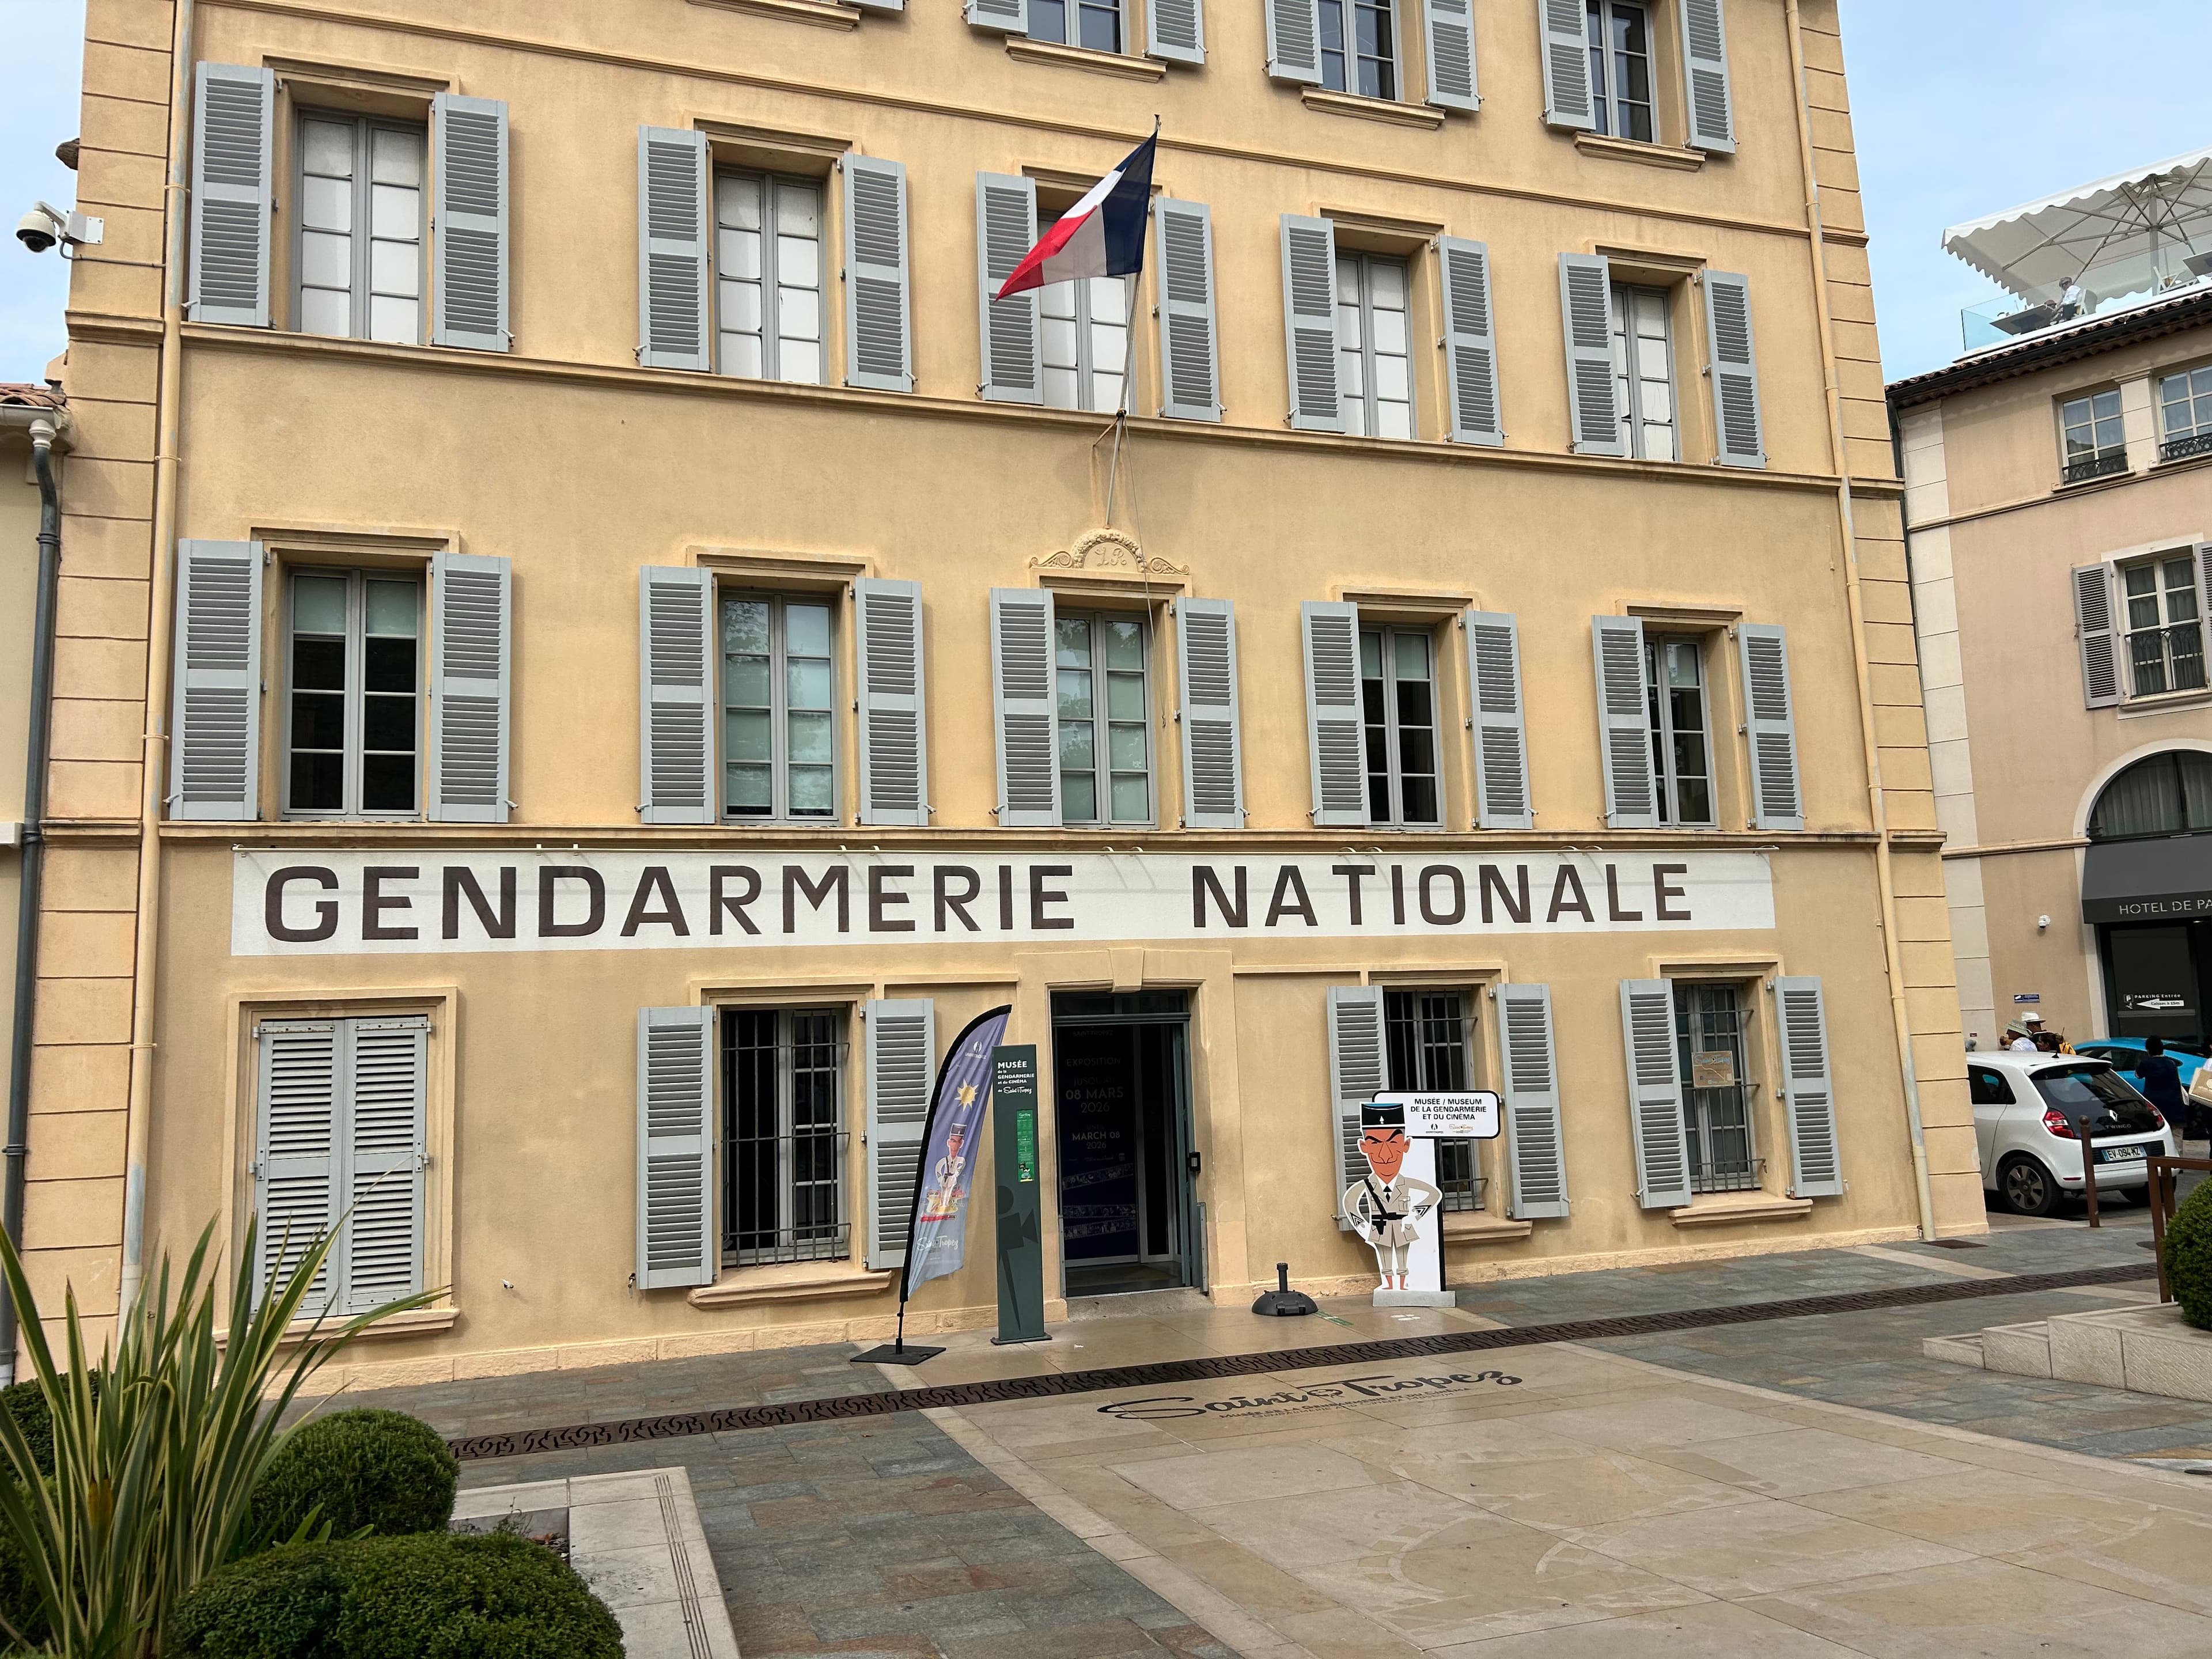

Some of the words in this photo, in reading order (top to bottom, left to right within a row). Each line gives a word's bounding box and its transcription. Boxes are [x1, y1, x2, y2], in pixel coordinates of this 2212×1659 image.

[265, 865, 1074, 942] GENDARMERIE
[1192, 863, 1691, 929] NATIONALE
[2119, 902, 2168, 915] HOTEL
[2172, 900, 2192, 911] DE
[998, 1060, 1027, 1069] MUSÉE
[1066, 1056, 1122, 1067] EXPOSITION
[1065, 1089, 1081, 1100] 08
[1086, 1087, 1124, 1099] MARS
[1081, 1102, 1111, 1113] 2026
[1072, 1131, 1107, 1141] MARCH
[1109, 1131, 1120, 1139] 08
[1086, 1141, 1107, 1150] 2026
[1097, 1392, 1310, 1419] Saint
[1296, 1370, 1523, 1396] Tropez
